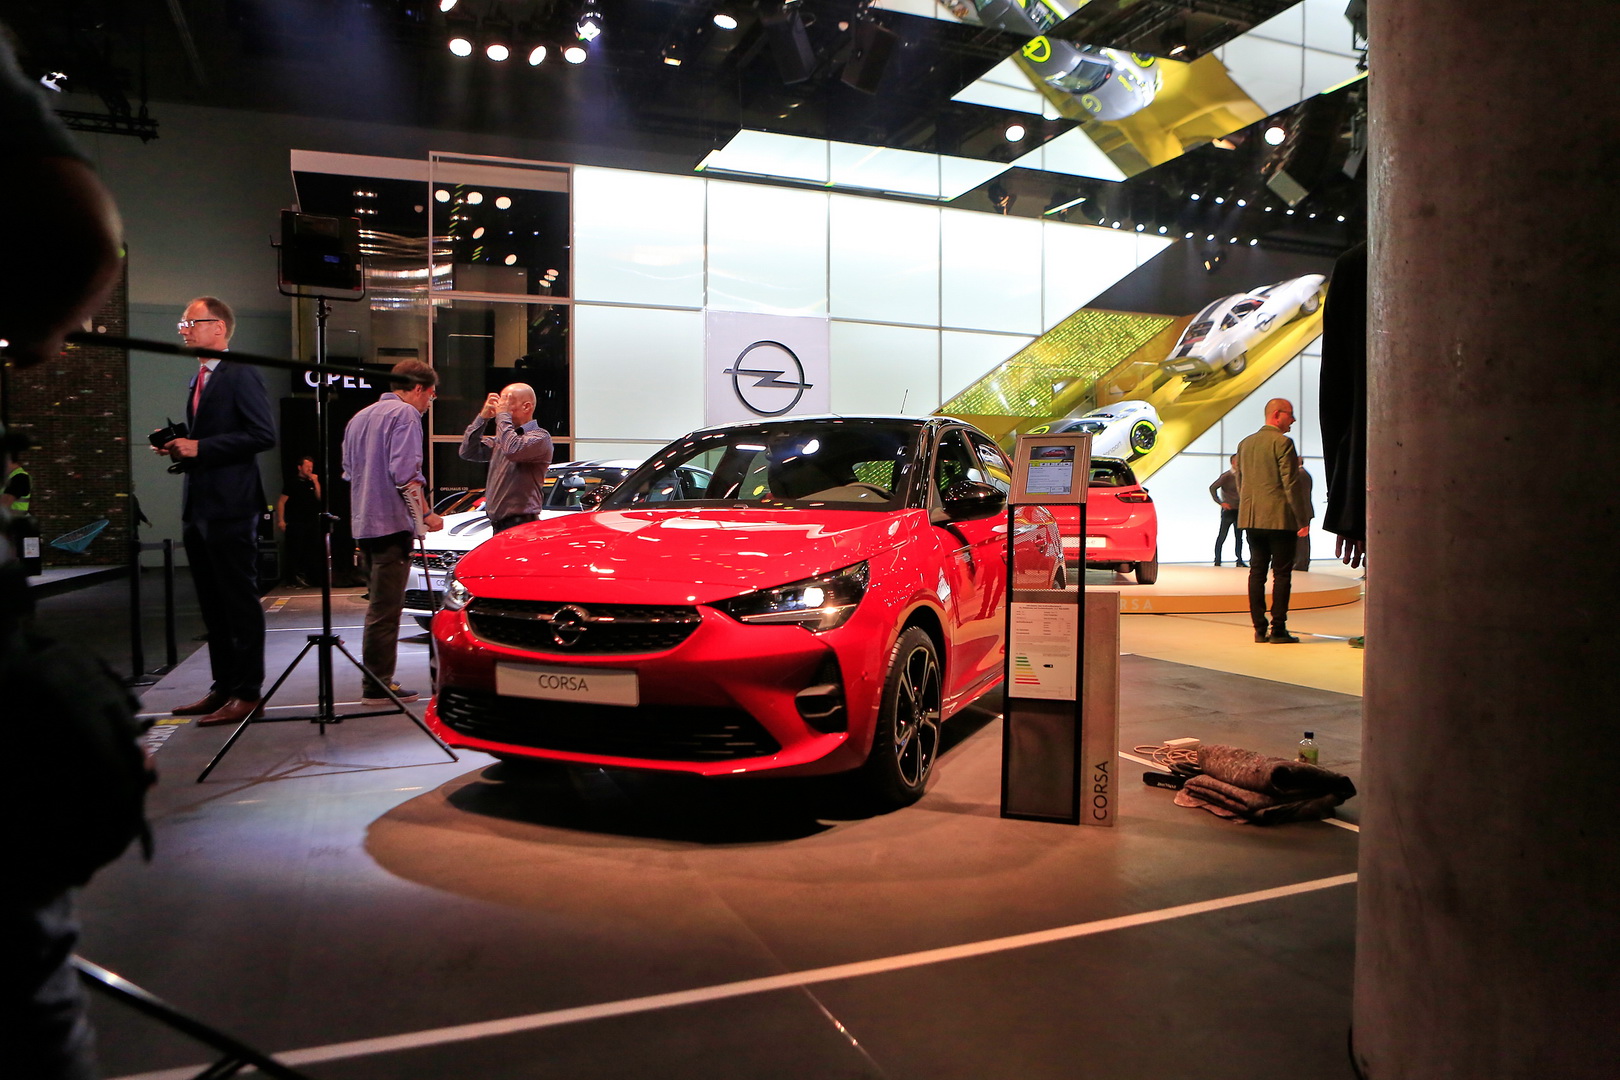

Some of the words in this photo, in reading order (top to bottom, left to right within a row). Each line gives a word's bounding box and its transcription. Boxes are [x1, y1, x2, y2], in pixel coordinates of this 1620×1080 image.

[305, 371, 372, 389] OPEL
[1120, 598, 1153, 611] RSA
[538, 674, 589, 692] CORSA
[1093, 760, 1109, 821] CORSA
